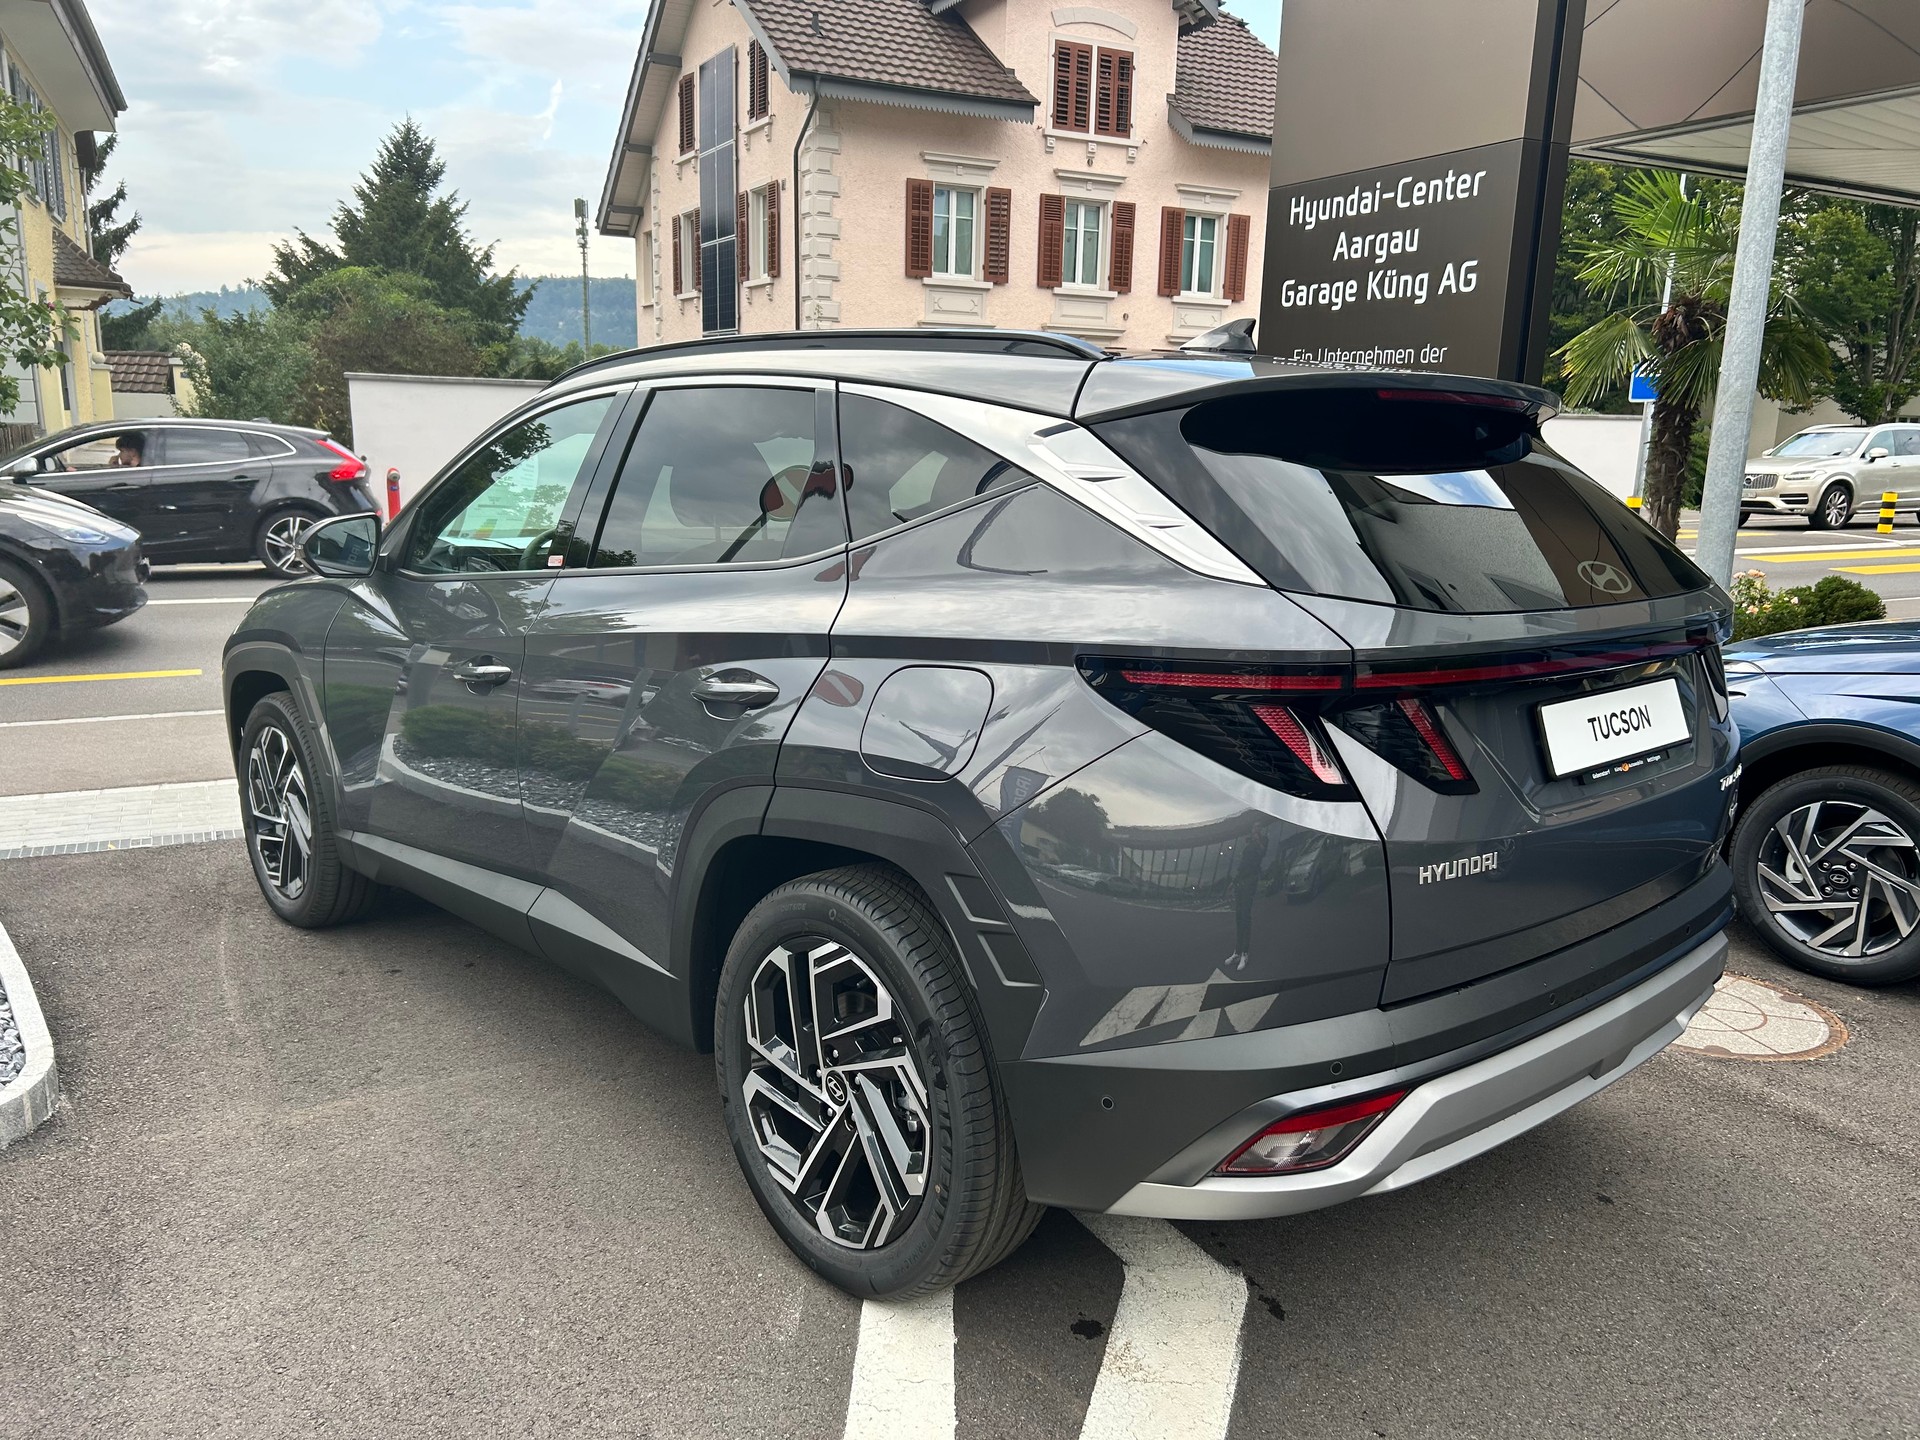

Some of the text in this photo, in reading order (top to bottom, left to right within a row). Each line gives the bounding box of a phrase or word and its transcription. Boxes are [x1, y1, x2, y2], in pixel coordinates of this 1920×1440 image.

[1289, 169, 1487, 230] Hyundai-Center
[1332, 228, 1420, 264] Aargau
[1281, 260, 1479, 311] Garage Küng AG
[1318, 345, 1415, 366] Unternehmen
[1420, 343, 1448, 364] der
[1587, 705, 1652, 742] TUCSON
[1418, 851, 1499, 885] HYUNDAI
